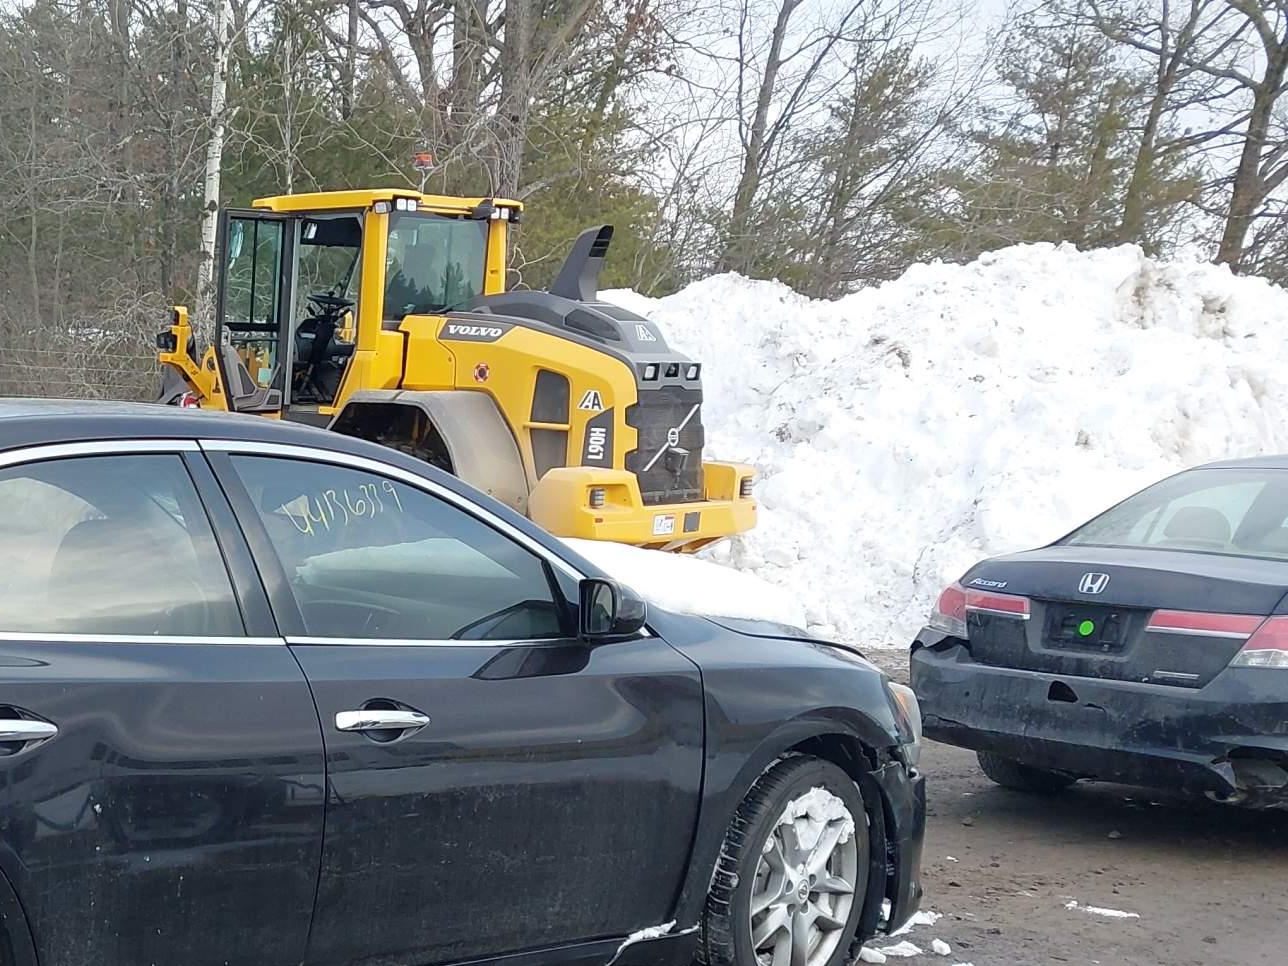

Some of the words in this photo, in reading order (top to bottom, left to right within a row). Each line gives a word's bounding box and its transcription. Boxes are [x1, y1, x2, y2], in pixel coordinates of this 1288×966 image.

[448, 324, 503, 337] VOLVO
[587, 427, 607, 460] L90H
[969, 577, 1008, 588] Accord
